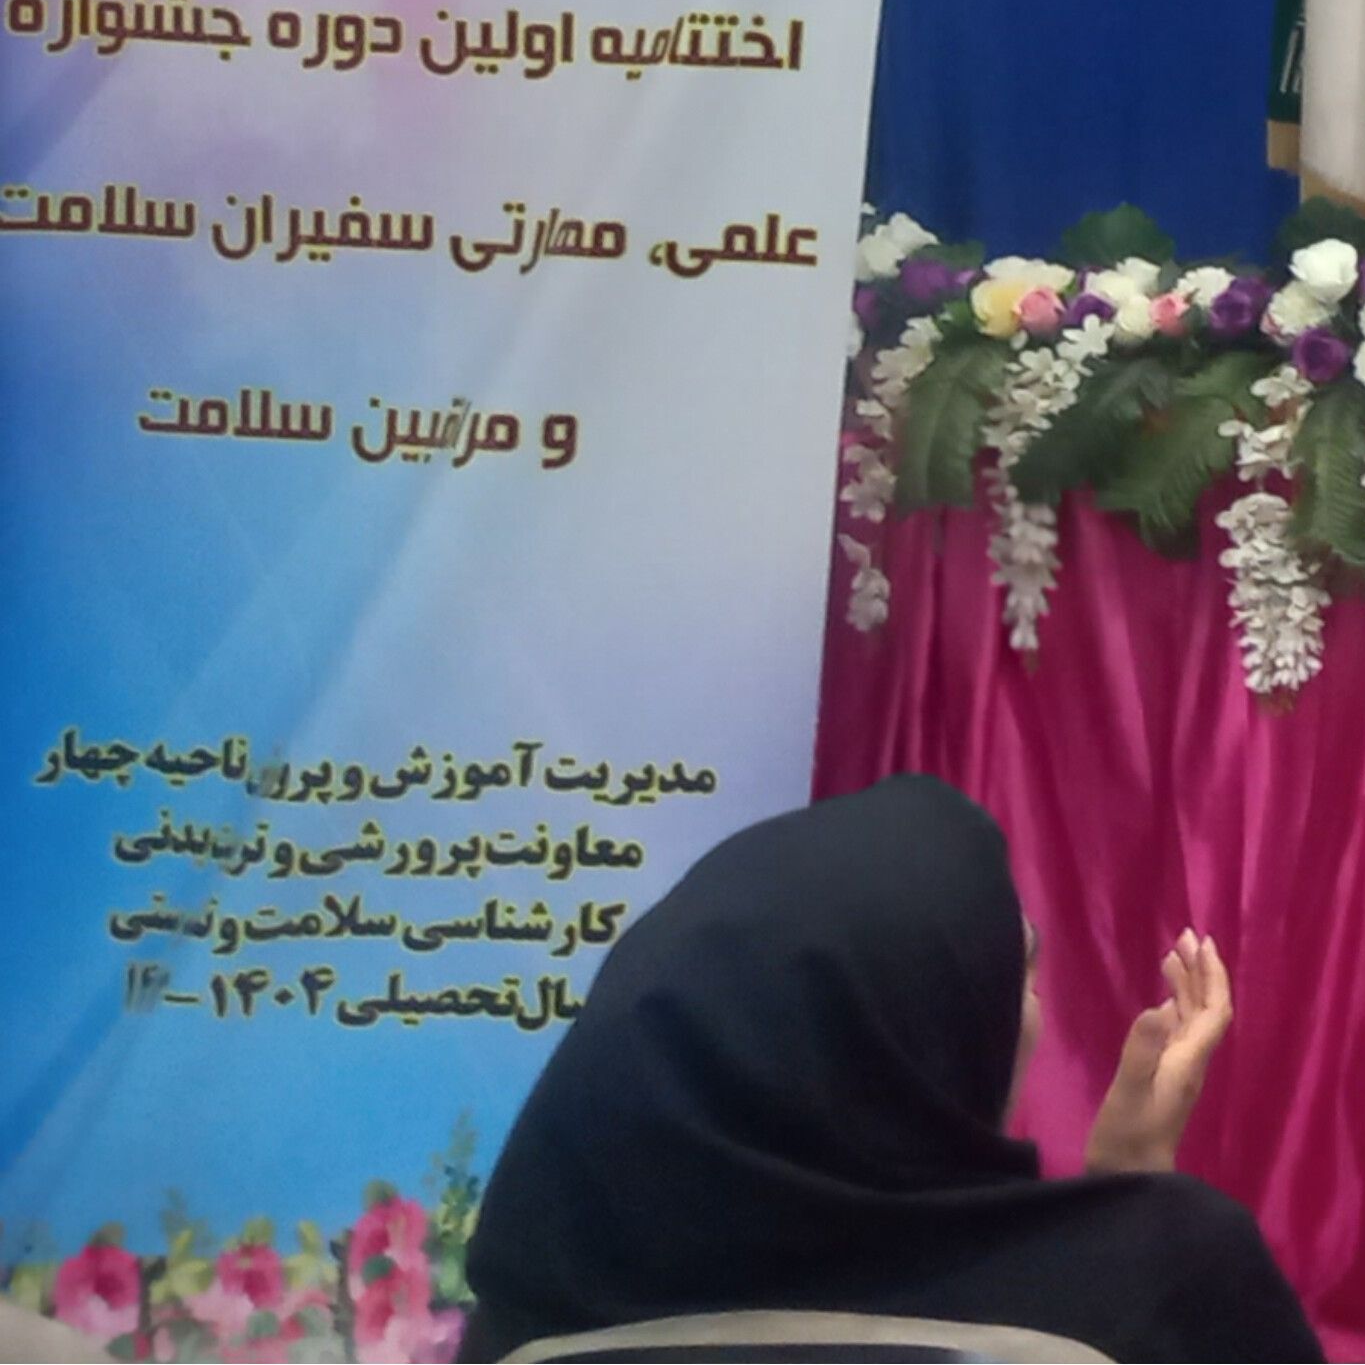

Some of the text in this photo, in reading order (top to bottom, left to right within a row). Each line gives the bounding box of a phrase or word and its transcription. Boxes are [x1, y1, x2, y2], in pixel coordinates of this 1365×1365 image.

[267, 10, 402, 71] دوره
[420, 9, 575, 80] اولین
[590, 11, 804, 81] اختتامیه
[0, 184, 196, 238] سلامت
[211, 193, 434, 263] سفیران
[449, 202, 627, 275] مهارتی
[138, 388, 332, 441] سلامت
[541, 413, 577, 470] و
[35, 728, 140, 786] چهار
[145, 737, 248, 786] ناحیه
[368, 741, 544, 800] آموزش
[544, 756, 717, 805] مدیریت
[298, 821, 482, 878] پرورشی
[484, 823, 643, 880] معاونت
[244, 893, 397, 942] سلامت
[401, 898, 626, 957] کارشناسی
[336, 972, 521, 1027] تحصیلی
